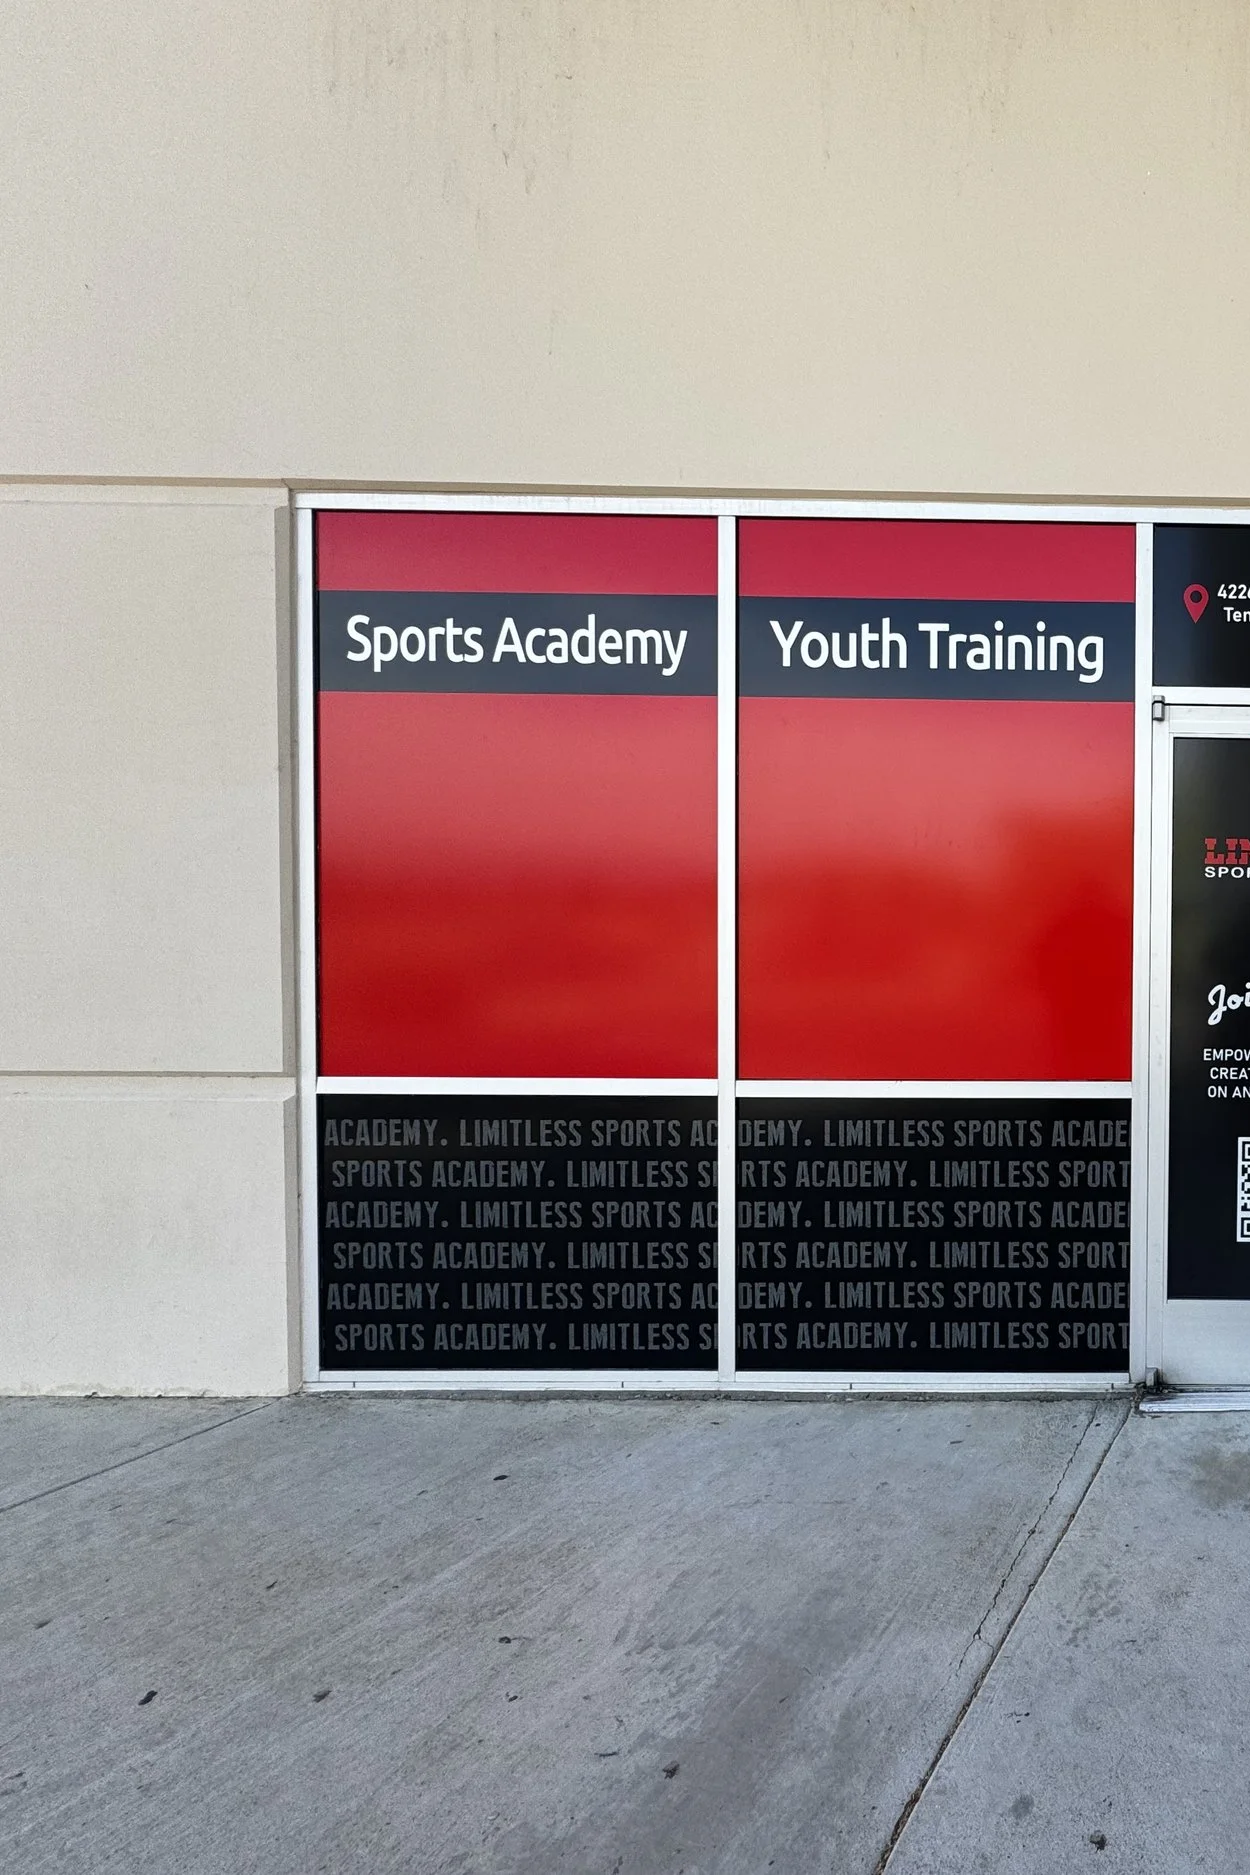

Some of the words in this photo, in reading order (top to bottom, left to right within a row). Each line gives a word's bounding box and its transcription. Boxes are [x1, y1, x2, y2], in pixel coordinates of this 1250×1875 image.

[346, 614, 484, 673] Sports
[492, 613, 688, 677] Academy
[769, 617, 908, 669] Youth
[918, 620, 1105, 684] Training
[1207, 1086, 1228, 1098] ON
[325, 1119, 447, 1146] ACADEMY.
[460, 1120, 581, 1146] LIMITLESS
[592, 1120, 680, 1146] SPORTS
[825, 1120, 944, 1147] LIMITLESS
[954, 1120, 1042, 1146] SPORTS
[333, 1160, 422, 1187] SPORTS
[432, 1161, 554, 1187] ACADEMY.
[568, 1161, 688, 1187] LIMITLESS
[796, 1161, 916, 1187] ACADEMY.
[930, 1161, 1049, 1187] LIMITLESS
[326, 1201, 448, 1228] ACADEMY.
[461, 1201, 582, 1228] LIMITLESS
[592, 1201, 680, 1228] SPORTS
[825, 1201, 944, 1228] LIMITLESS
[954, 1201, 1041, 1227] SPORTS
[334, 1242, 423, 1269] SPORTS
[433, 1242, 555, 1269] ACADEMY.
[568, 1242, 688, 1269] LIMITLESS
[796, 1242, 917, 1268] ACADEMY.
[930, 1242, 1048, 1268] LIMITLESS
[327, 1283, 449, 1309] ACADEMY.
[462, 1283, 582, 1309] LIMITLESS
[593, 1283, 681, 1309] SPORTS
[825, 1282, 944, 1308] LIMITLESS
[954, 1282, 1041, 1308] SPORTS
[335, 1324, 424, 1350] SPORTS
[434, 1324, 556, 1350] ACADEMY.
[569, 1323, 689, 1350] LIMITLESS
[797, 1322, 917, 1349] ACADEMY.
[930, 1322, 1048, 1348] LIMITLESS
